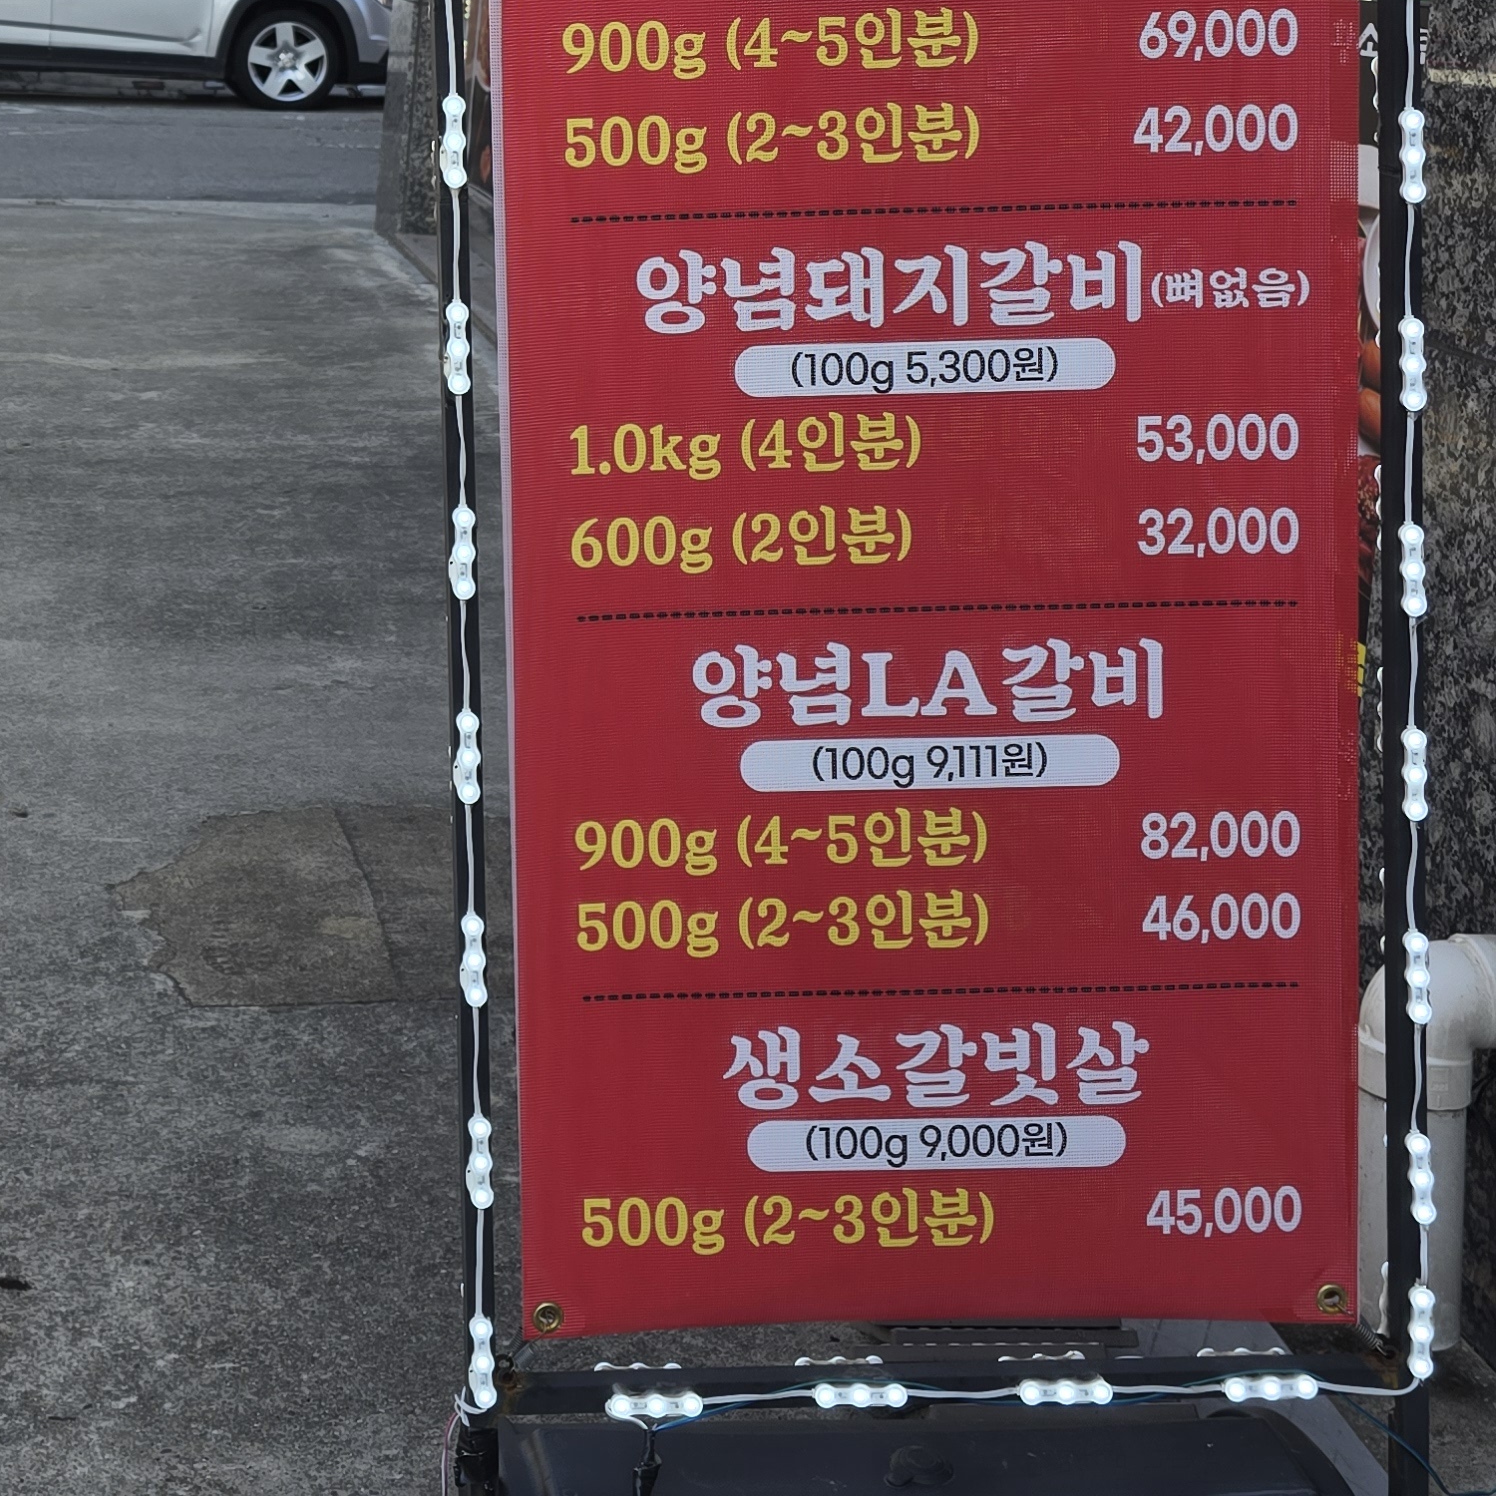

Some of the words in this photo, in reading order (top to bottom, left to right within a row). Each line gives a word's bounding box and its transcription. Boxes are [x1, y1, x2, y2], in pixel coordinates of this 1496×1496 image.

[562, 20, 707, 80] 900g
[727, 8, 979, 74] (4~5인분)
[1138, 8, 1299, 63] 69,000
[564, 115, 707, 175] 500g
[727, 102, 980, 168] (2~3인분)
[1134, 104, 1299, 157] 42,000
[635, 241, 1143, 335] 양념돼지갈비
[791, 350, 895, 393] (100g
[905, 346, 1058, 388] 5,300원)
[569, 423, 721, 482] 1.0kg
[741, 411, 921, 475] (4인분)
[1136, 413, 1299, 466] 53,000
[571, 517, 713, 575] 600g
[732, 504, 912, 568] (2인분)
[1137, 506, 1299, 559] 32,000
[692, 637, 1164, 729] 양념LA갈비
[812, 747, 915, 788] (100g
[925, 741, 1048, 783] 9,111원)
[575, 818, 718, 877] 900g
[737, 807, 988, 870] (4~5인분)
[1141, 810, 1301, 865] 82,000
[576, 901, 720, 959] 500g
[738, 889, 989, 953] (2~3인분)
[1141, 891, 1301, 946] 46,000
[723, 1021, 1150, 1111] 생소갈빗살
[806, 1124, 908, 1168] (100g
[919, 1119, 1068, 1163] 9,000원)
[582, 1197, 725, 1255] 500g
[745, 1186, 995, 1250] (2~3인분)
[1146, 1185, 1301, 1239] 45,000
